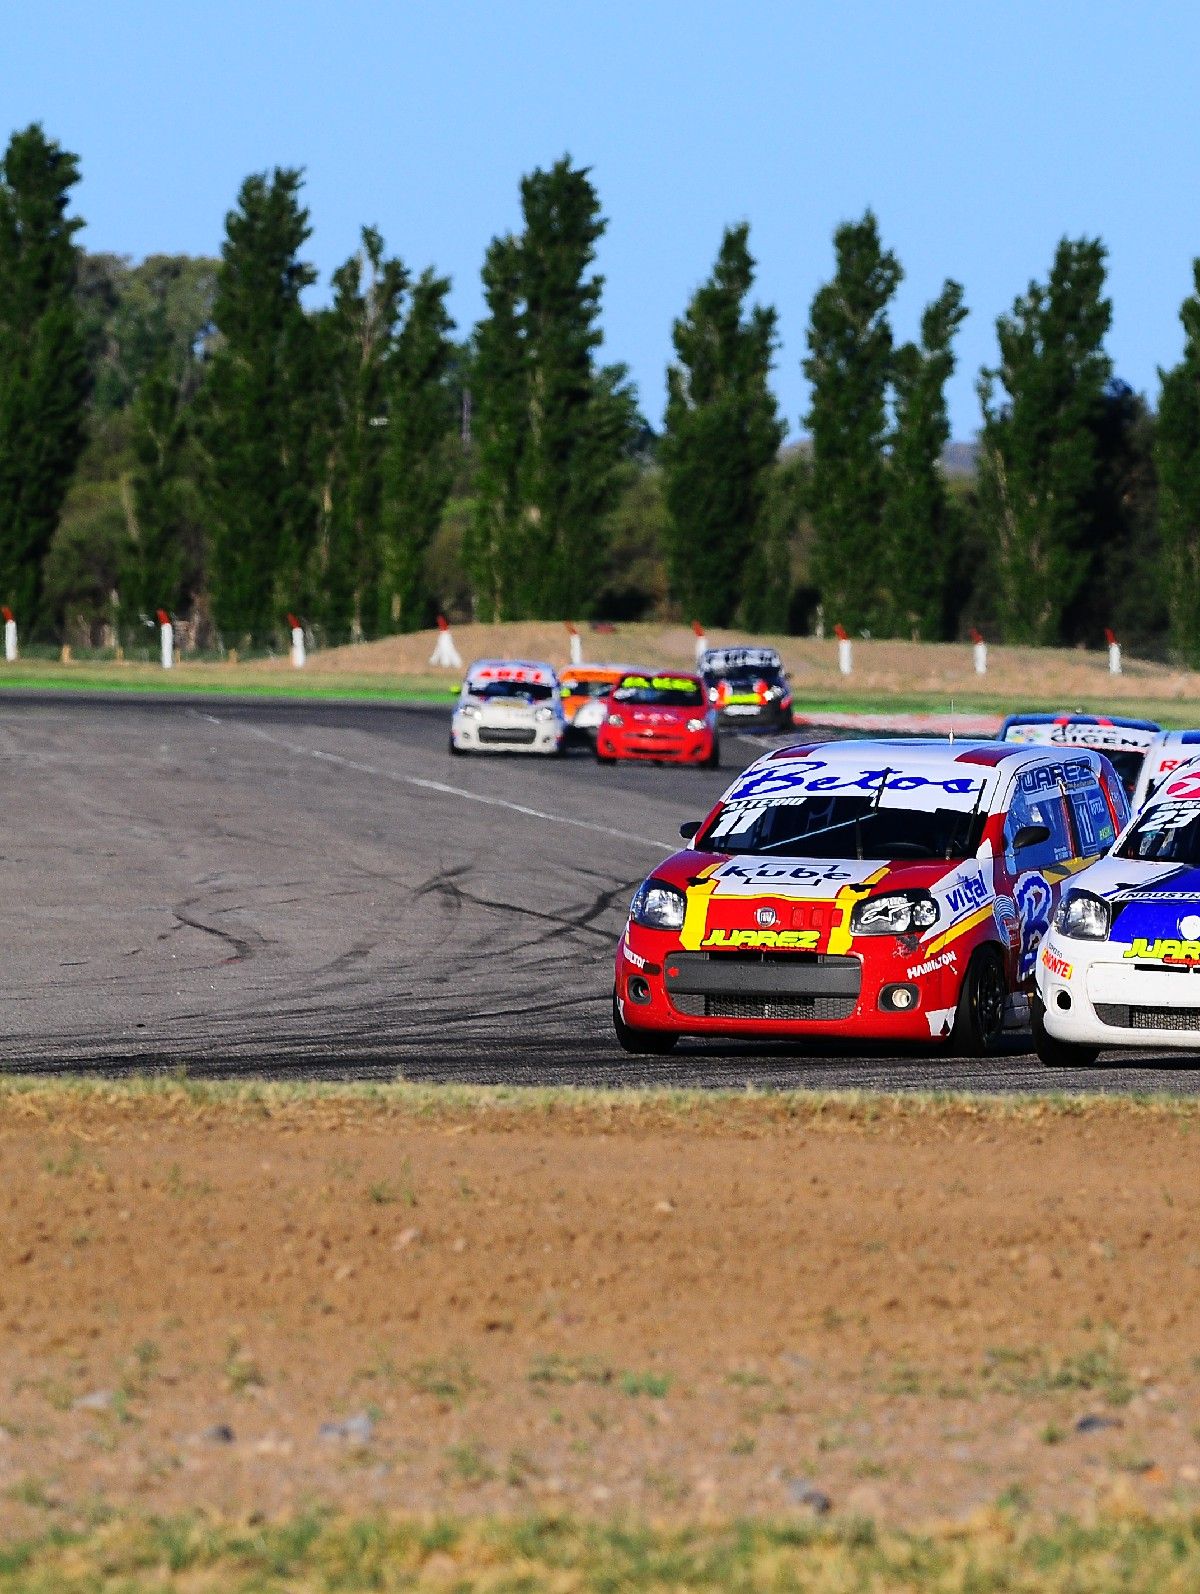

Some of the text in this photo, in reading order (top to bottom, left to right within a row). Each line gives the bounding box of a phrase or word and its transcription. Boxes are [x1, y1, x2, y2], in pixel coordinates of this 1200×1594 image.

[710, 806, 758, 838] 11
[701, 929, 821, 949] JUAREZ
[907, 951, 958, 980] HAMILTON
